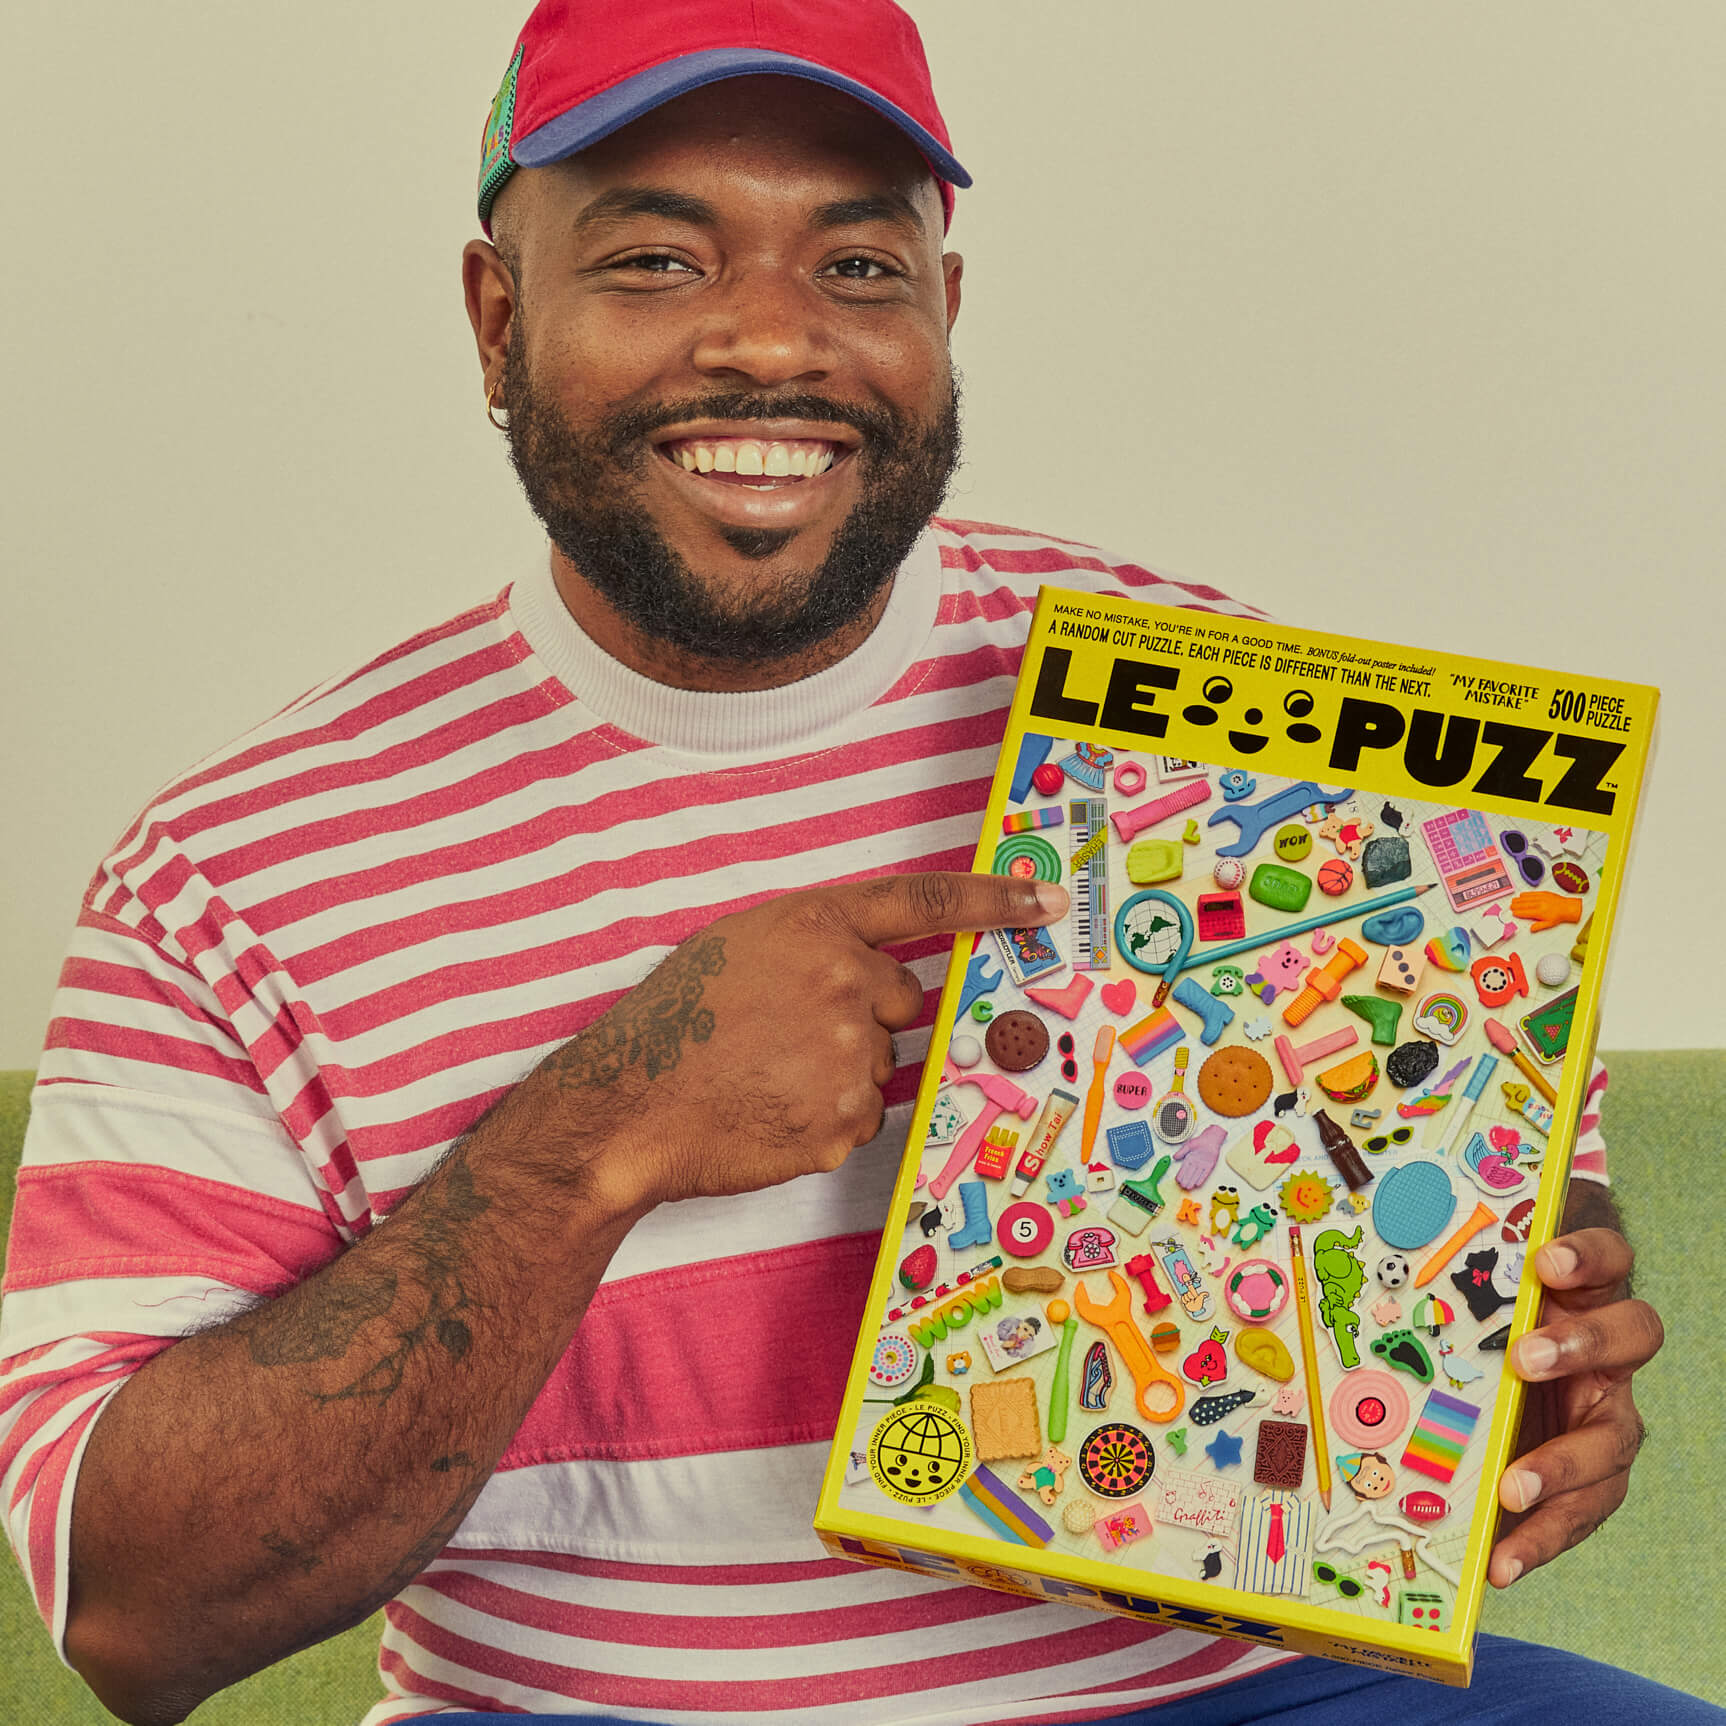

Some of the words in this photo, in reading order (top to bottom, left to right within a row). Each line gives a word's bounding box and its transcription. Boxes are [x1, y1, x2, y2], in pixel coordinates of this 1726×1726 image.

[1054, 604, 1083, 618] MAKE
[1085, 610, 1102, 620] NO
[1104, 612, 1150, 630] MISTAKE,
[1154, 620, 1193, 637] YOU'RE
[1194, 627, 1206, 638] IN
[1208, 630, 1230, 642] FOR
[1231, 633, 1240, 644] A
[1242, 635, 1274, 650] GOOD
[1277, 641, 1304, 655] TIME.
[1306, 645, 1340, 661] BONUS
[1339, 652, 1372, 666] fold-out
[1371, 659, 1397, 670] poster
[1399, 663, 1437, 677] included!
[1048, 620, 1058, 635] A
[1060, 621, 1111, 644] RANDOM
[1112, 631, 1137, 649] CUT
[1139, 635, 1184, 657] PUZZLE.
[1188, 643, 1221, 662] EACH
[1223, 649, 1257, 669] PIECE
[1259, 655, 1272, 671] IS
[1274, 657, 1338, 682] DIFFERENT
[1341, 668, 1372, 687] THAN
[1375, 674, 1398, 692] THE
[1399, 678, 1432, 698] NEXT.
[1450, 673, 1476, 688] "MY
[1478, 678, 1540, 700] FAVORITE
[1464, 690, 1529, 711] MISTAKE"
[1548, 688, 1588, 724] 500
[1589, 694, 1625, 714] PIECE
[1030, 646, 1181, 739] LE
[1328, 696, 1627, 816] PUZZ
[1586, 711, 1633, 733] PUZZLE
[1279, 833, 1309, 849] WOW
[1048, 1113, 1063, 1131] Tai
[1019, 1221, 1032, 1238] 5
[908, 1275, 1003, 1349] WOW
[885, 1407, 907, 1424] PIECE
[927, 1405, 948, 1416] PUZZ
[872, 1421, 887, 1447] INNER
[951, 1418, 966, 1435] FIND
[869, 1448, 877, 1471] YOUR
[962, 1436, 971, 1462] YOUR
[874, 1471, 888, 1489] FIND
[957, 1462, 970, 1485] INNER
[893, 1491, 913, 1503] PUZZ
[935, 1484, 956, 1500] PIECE
[1173, 1508, 1227, 1528] Graffiti
[838, 1536, 961, 1575] LE
[1039, 1577, 1285, 1642] PUZZ
